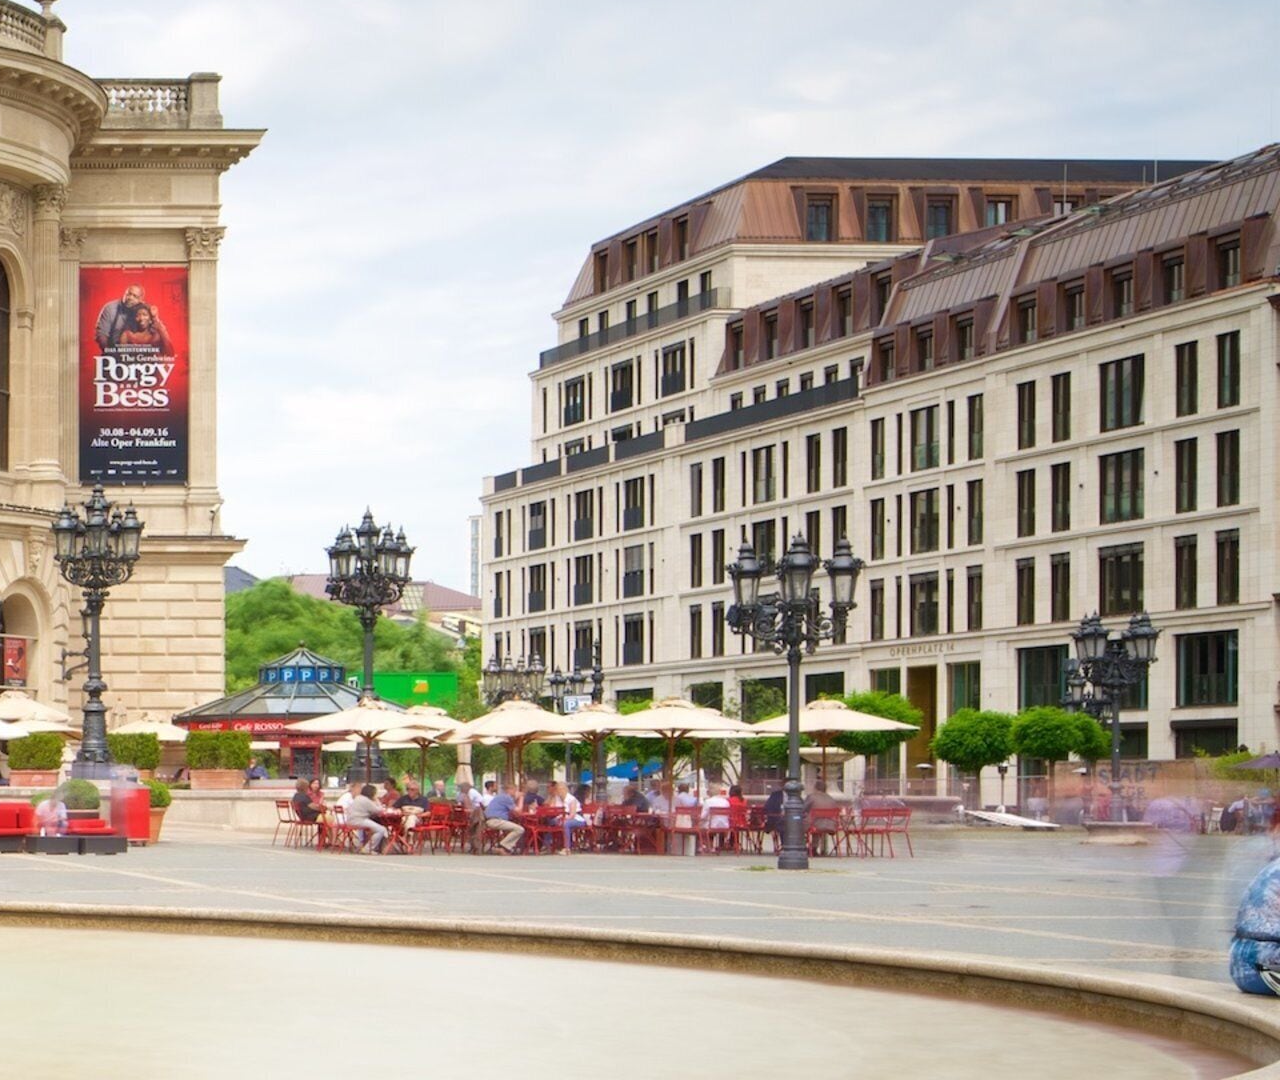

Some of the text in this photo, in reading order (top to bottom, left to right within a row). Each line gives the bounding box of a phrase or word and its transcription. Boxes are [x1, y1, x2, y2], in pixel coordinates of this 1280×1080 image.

[120, 354, 135, 362] The
[93, 356, 175, 387] Porgy
[93, 382, 169, 408] Bess
[91, 437, 177, 450] Alte Oper Frankfurt
[889, 642, 944, 657] OPERNPLATZ
[283, 671, 293, 682] P
[302, 671, 312, 682] P
[320, 671, 328, 682] P
[567, 700, 576, 711] P
[254, 722, 284, 731] ROSSO
